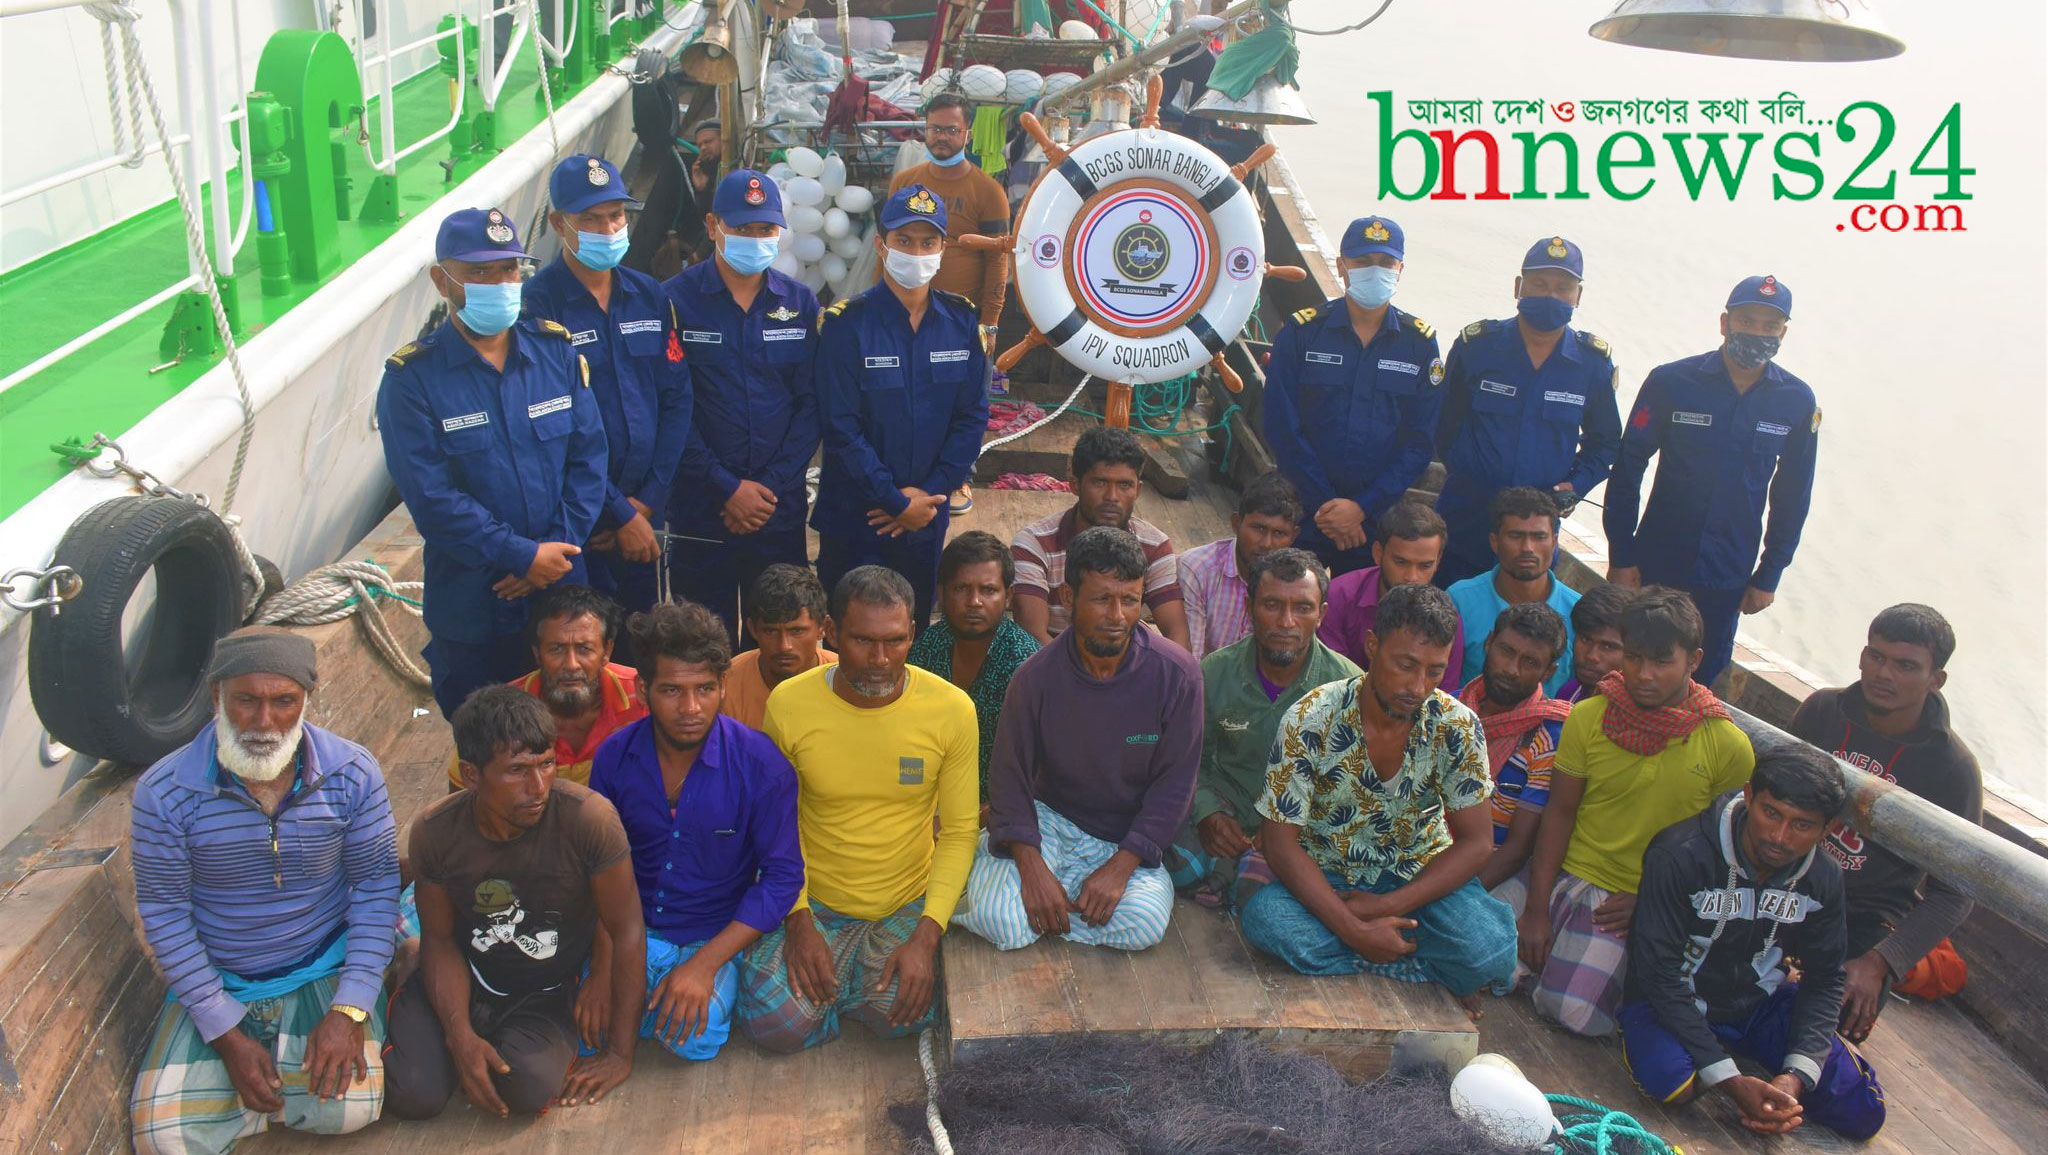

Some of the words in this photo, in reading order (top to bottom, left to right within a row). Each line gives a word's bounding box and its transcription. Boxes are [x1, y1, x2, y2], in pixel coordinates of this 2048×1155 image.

[1085, 150, 1124, 183] BCGS
[1127, 147, 1171, 172] SONAR
[1173, 152, 1221, 194] BANGLA
[1081, 333, 1109, 359] IPV
[1112, 337, 1190, 369] SQUADRON
